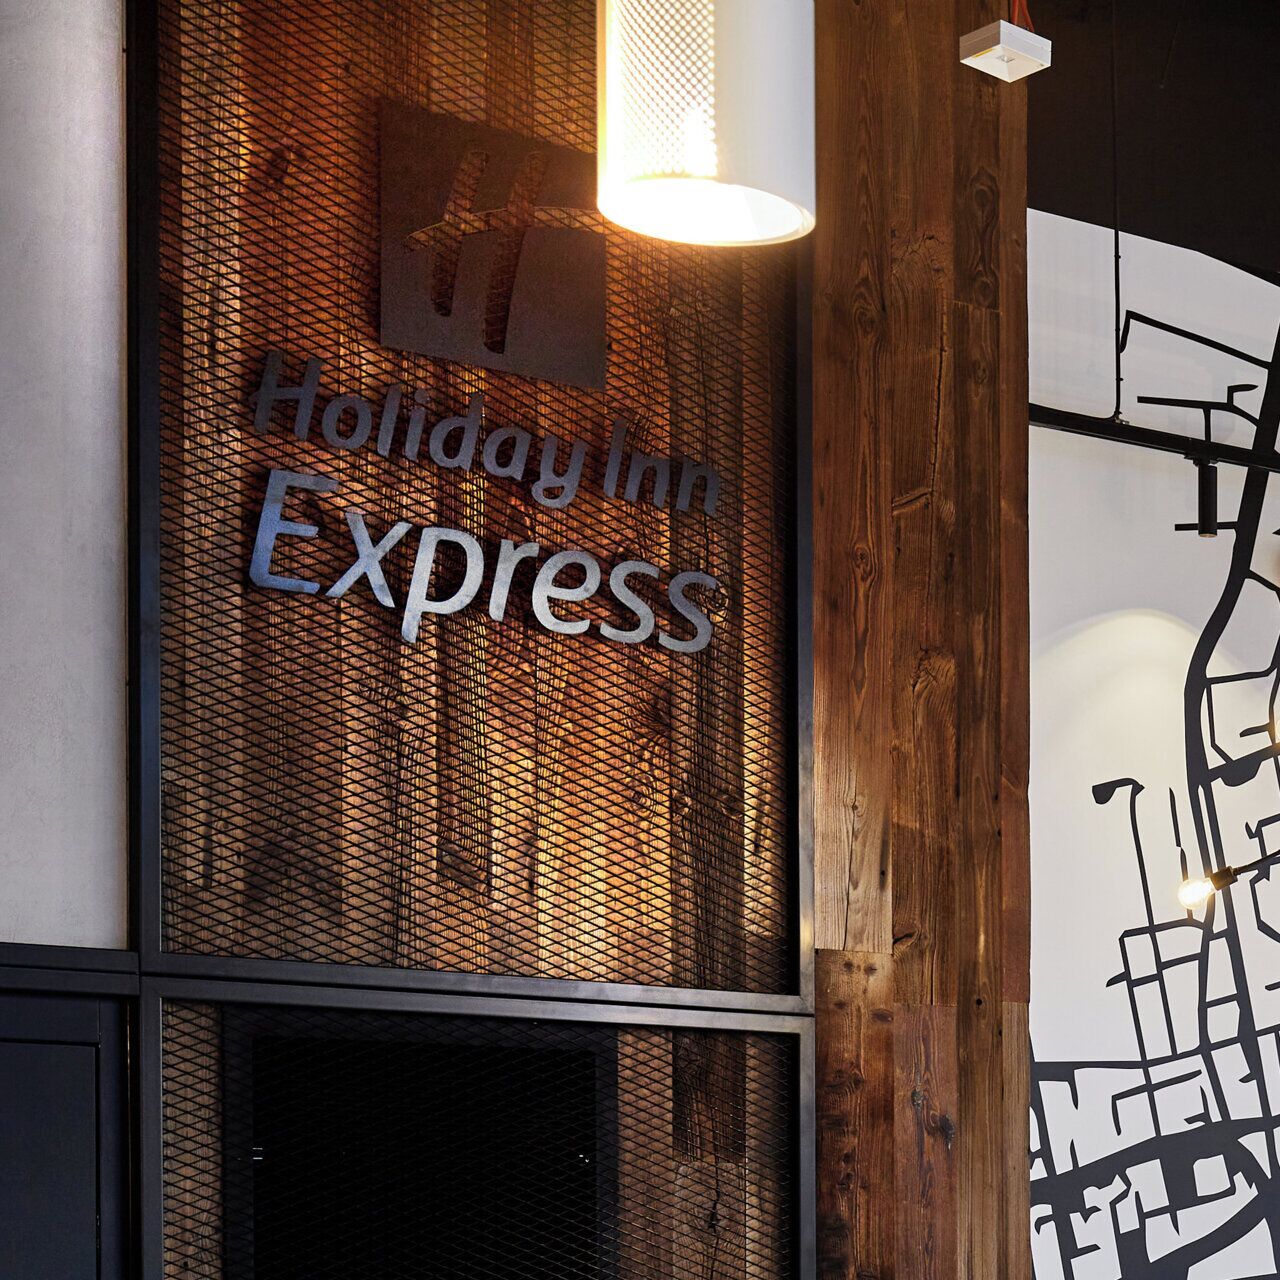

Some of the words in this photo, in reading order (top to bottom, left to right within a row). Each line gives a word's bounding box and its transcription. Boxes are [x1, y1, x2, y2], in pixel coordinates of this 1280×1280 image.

[253, 351, 588, 509] Holiday
[603, 418, 721, 517] Inn
[248, 469, 719, 654] Express
